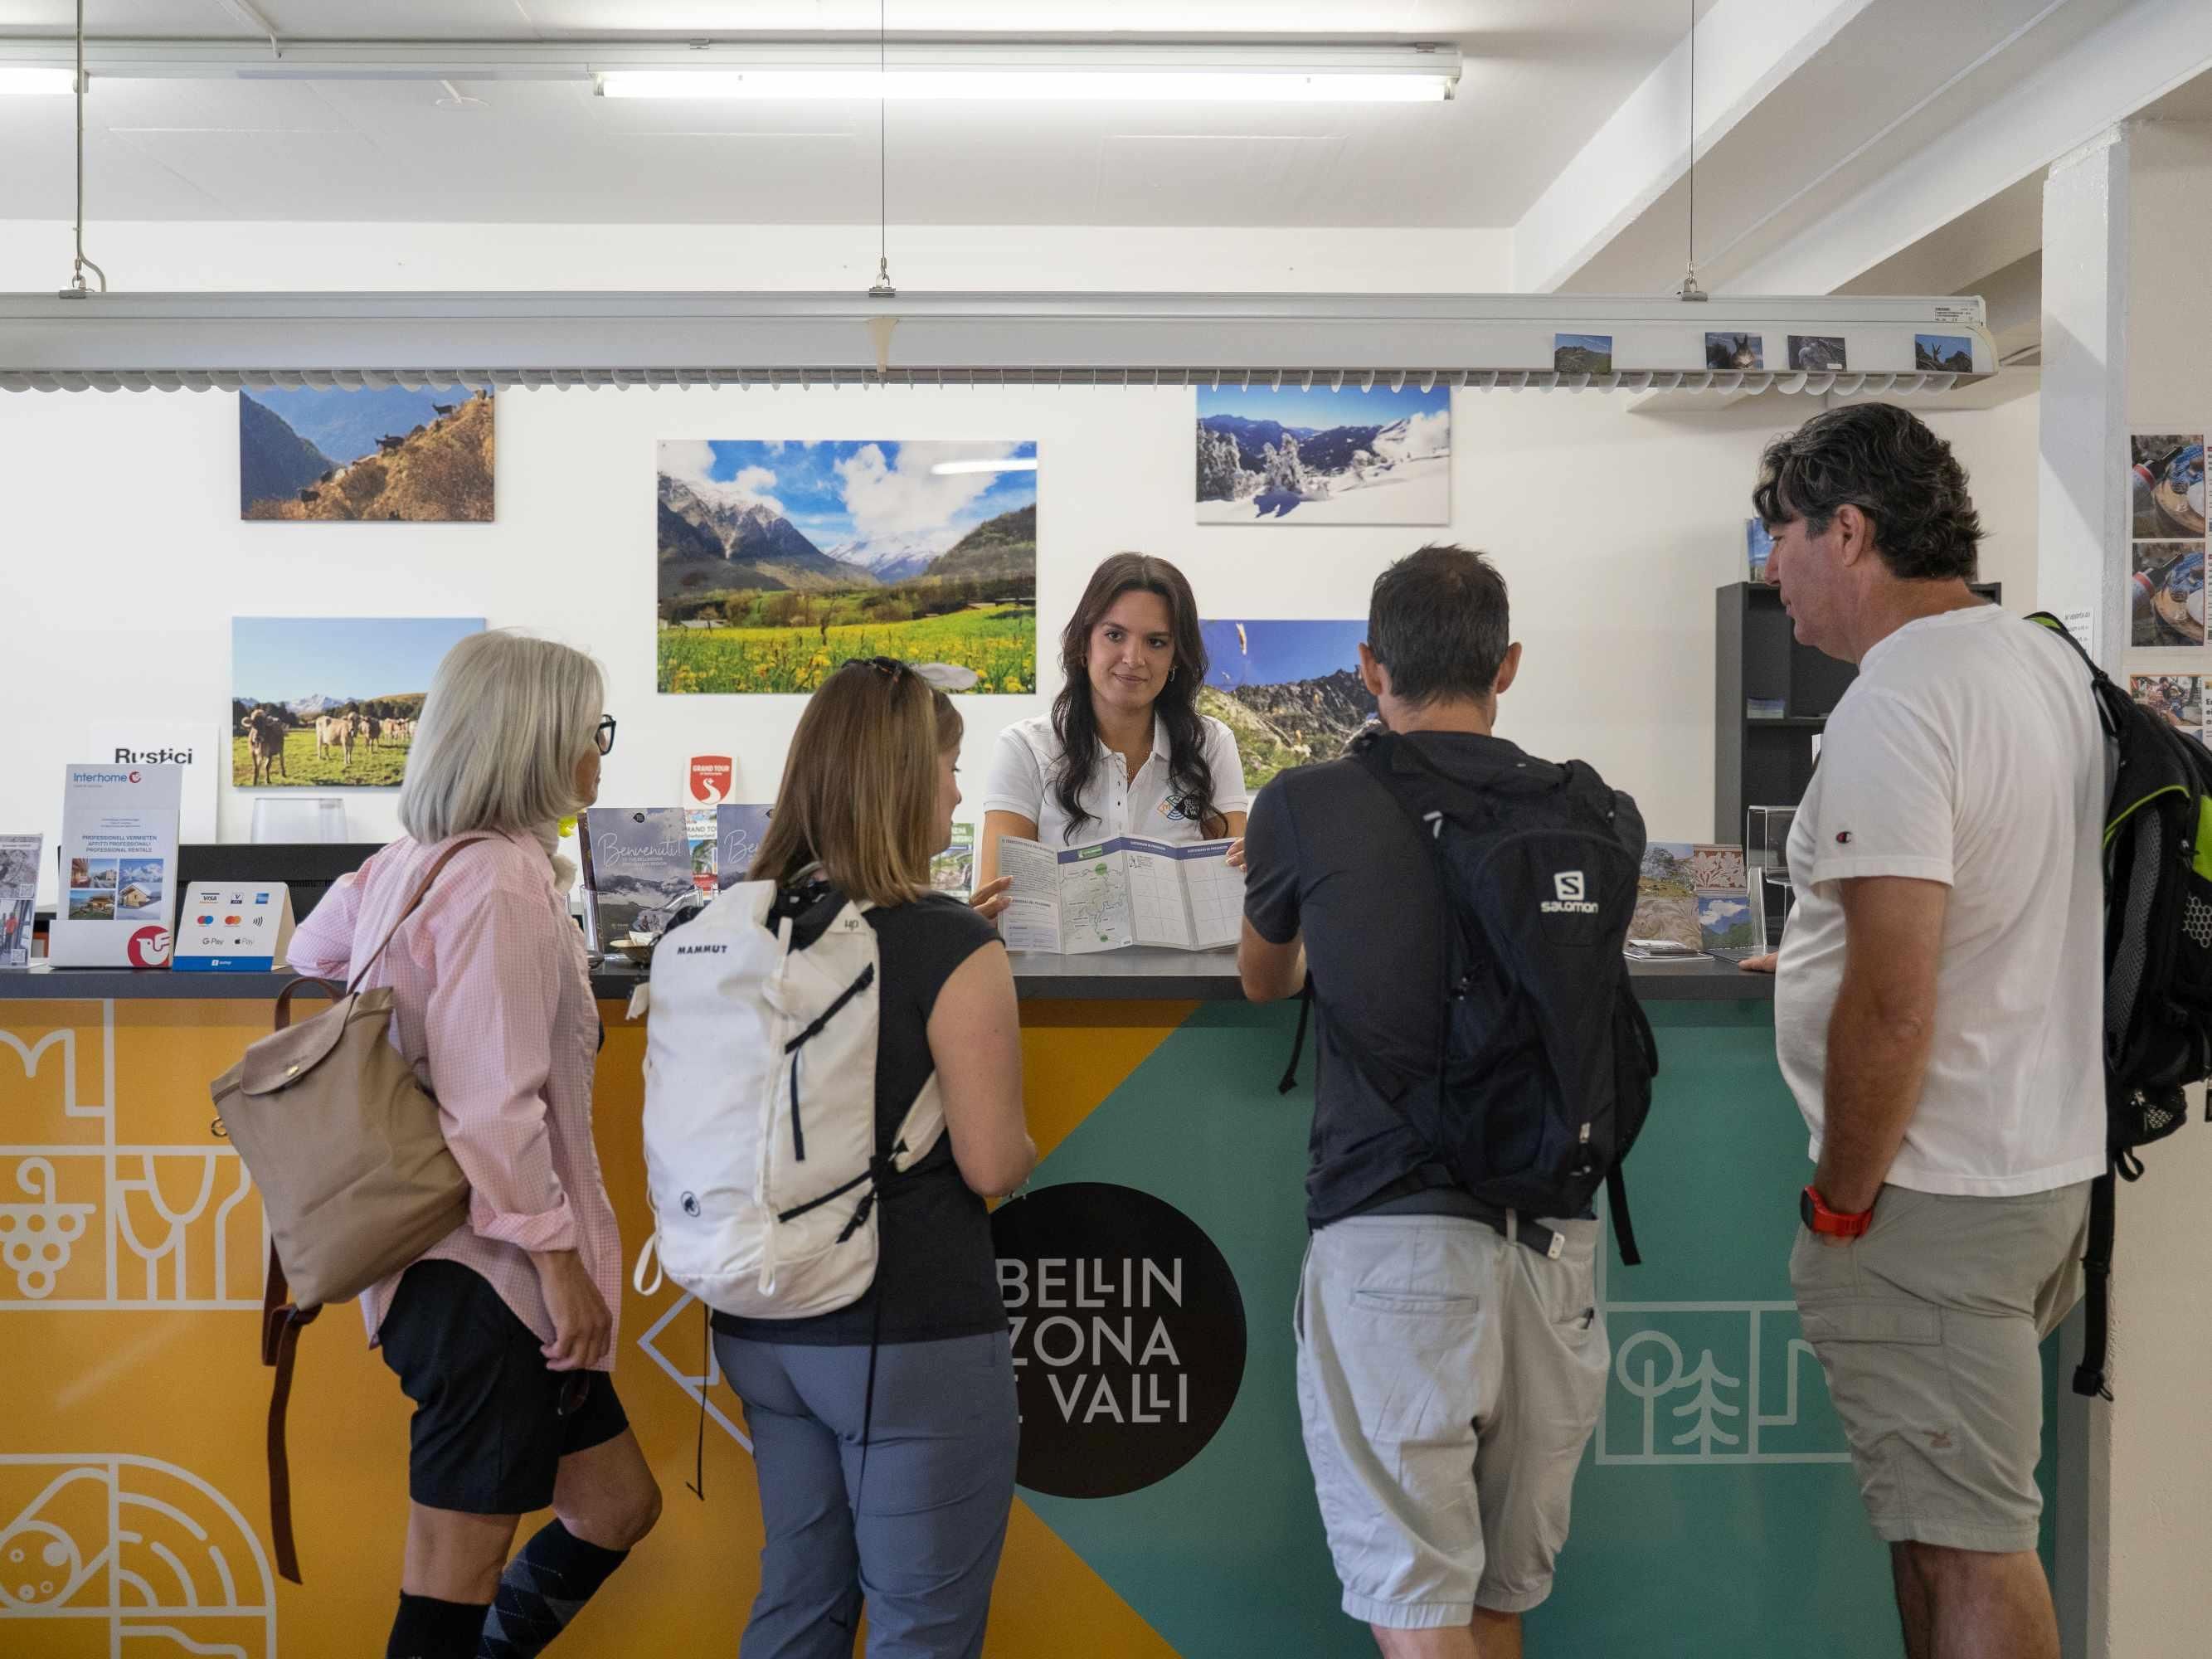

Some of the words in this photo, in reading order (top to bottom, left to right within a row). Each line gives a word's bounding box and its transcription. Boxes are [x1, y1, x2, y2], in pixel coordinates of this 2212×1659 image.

[114, 747, 192, 764] Rustici
[73, 772, 128, 782] Interhome
[677, 945, 728, 954] MAMMUT
[995, 1258, 1182, 1307] BELLIN
[1048, 1374, 1188, 1423] VALLI
